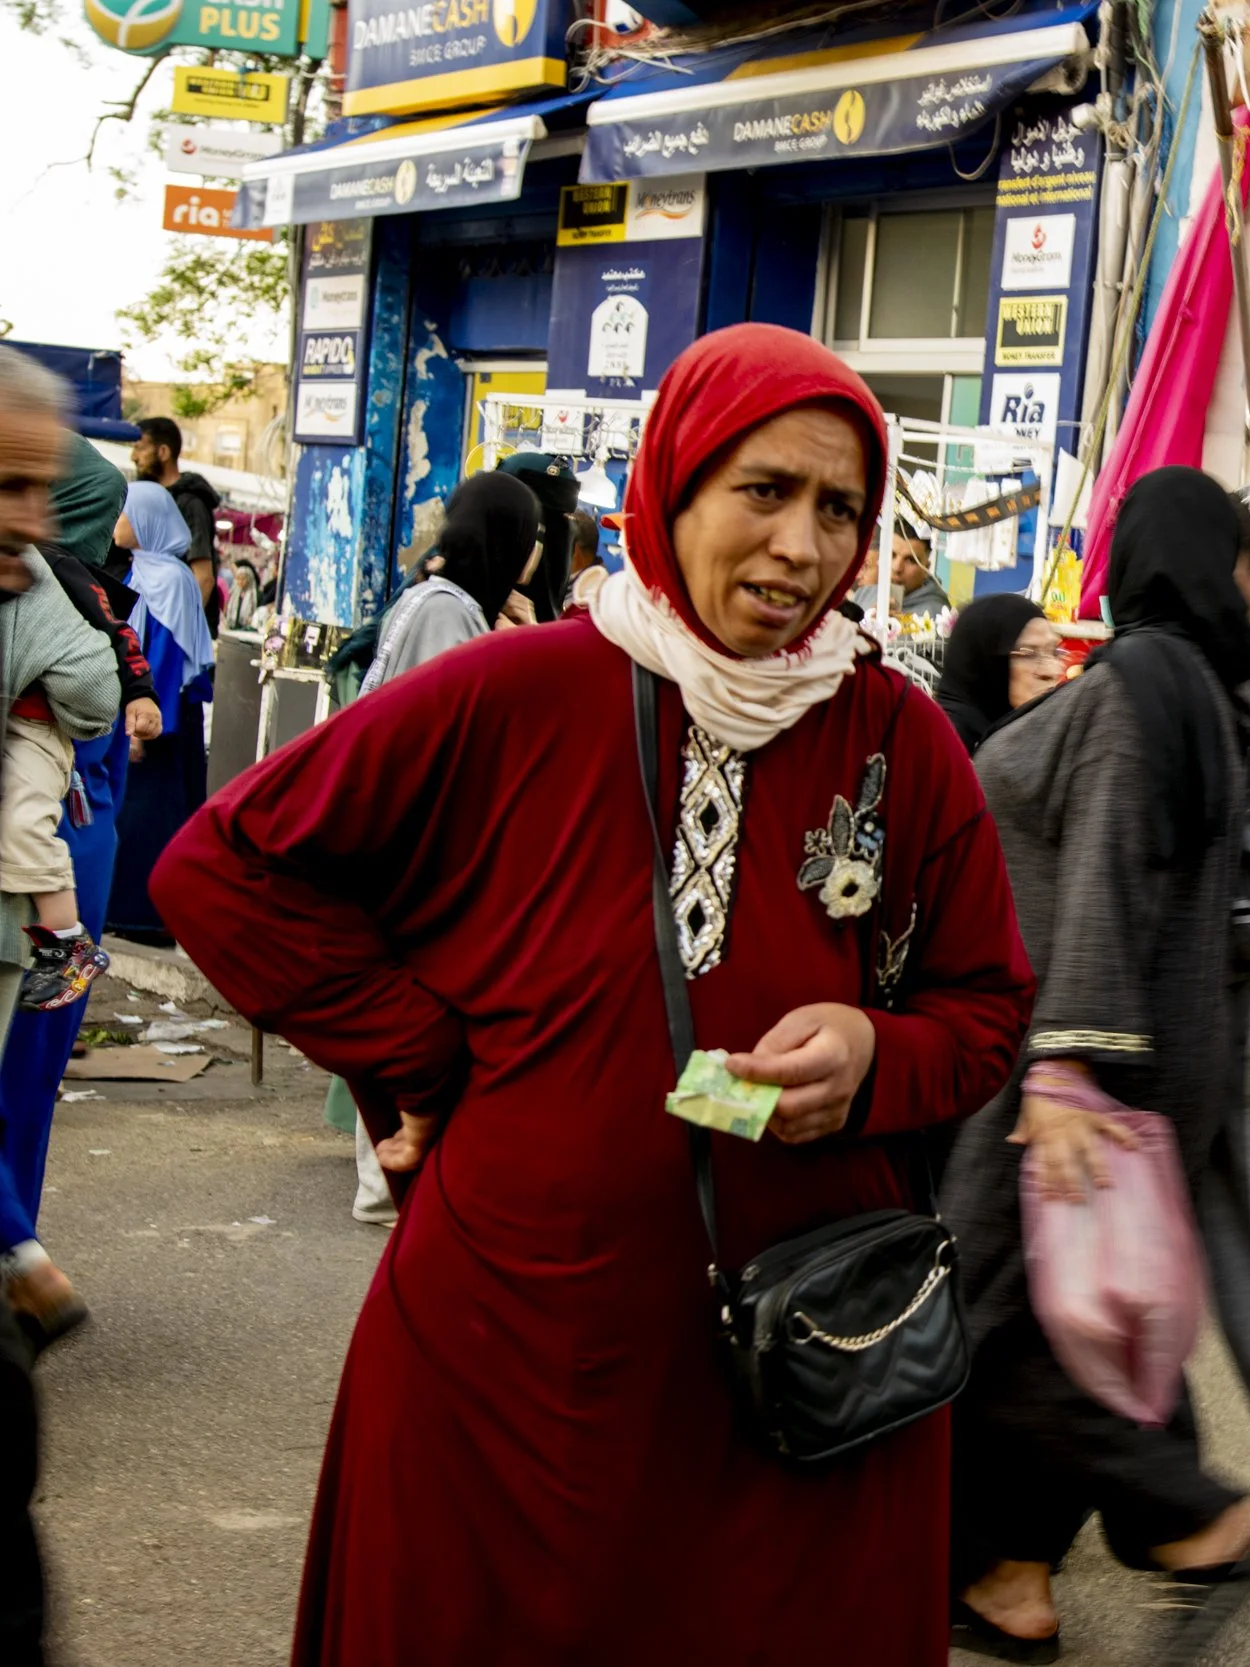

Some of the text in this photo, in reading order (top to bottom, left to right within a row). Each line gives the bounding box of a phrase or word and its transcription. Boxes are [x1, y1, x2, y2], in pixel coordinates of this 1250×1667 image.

[199, 7, 280, 40] PLUS
[733, 110, 831, 142] DAMANECASH
[172, 195, 220, 228] ria
[635, 190, 696, 209] Moneytrans
[1002, 303, 1055, 321] WESTERN
[1016, 318, 1056, 336] UNION
[304, 336, 354, 364] RAPIDO
[1001, 382, 1046, 424] Ria
